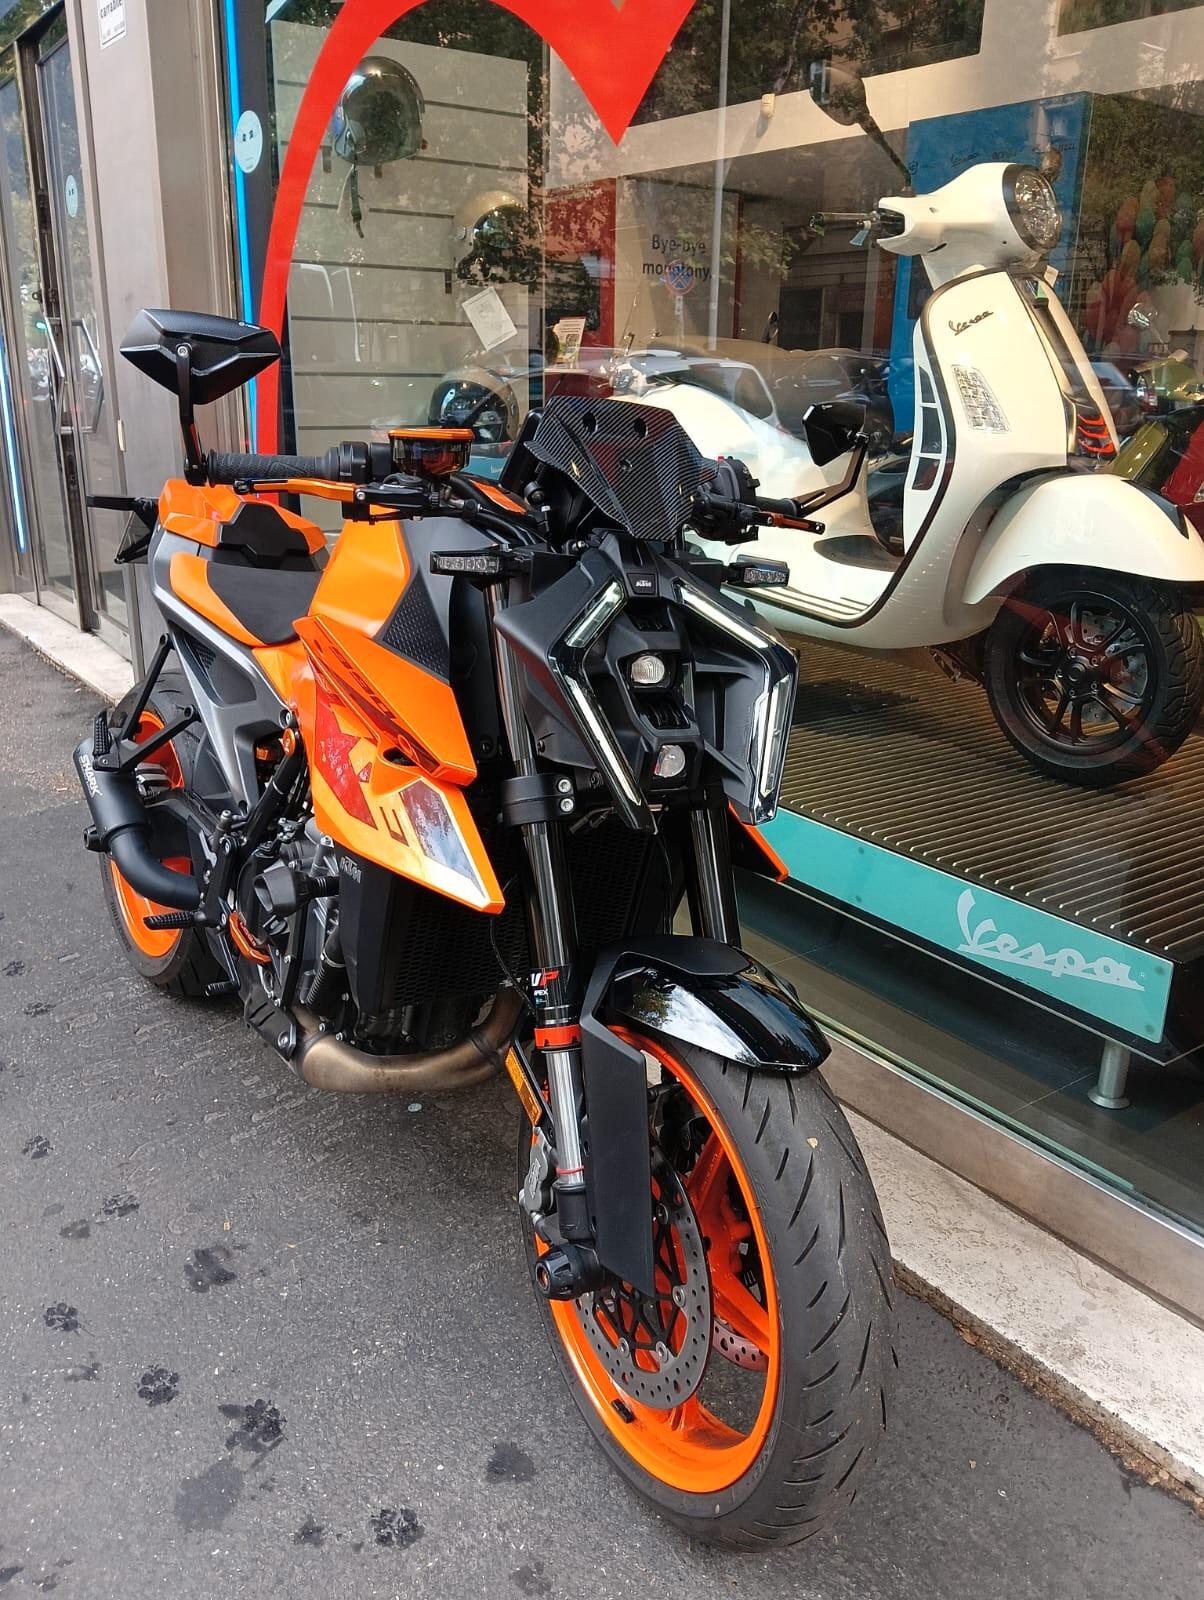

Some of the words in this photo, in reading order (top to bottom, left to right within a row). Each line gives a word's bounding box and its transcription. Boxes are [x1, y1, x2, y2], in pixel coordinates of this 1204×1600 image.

[652, 234, 706, 256] Bye-bye
[948, 310, 994, 336] Vespa
[79, 754, 103, 798] SHARK
[340, 855, 361, 884] KTM
[957, 888, 1145, 991] Vespa
